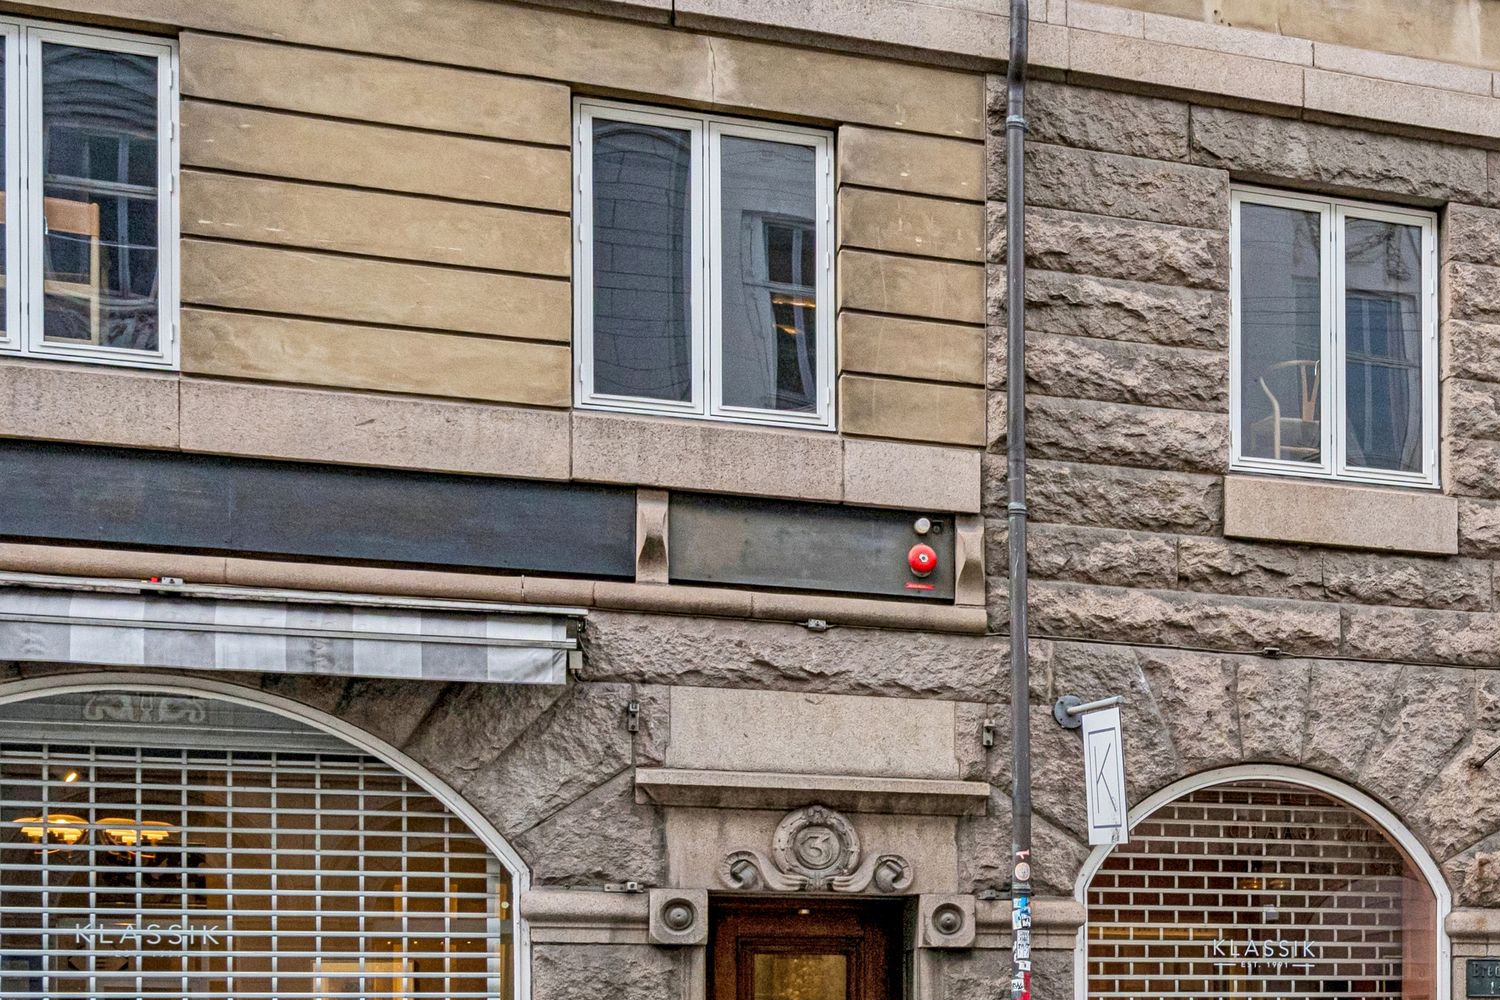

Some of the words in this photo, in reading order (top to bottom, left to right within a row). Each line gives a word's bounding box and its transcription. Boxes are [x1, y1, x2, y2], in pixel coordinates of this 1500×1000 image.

[1094, 743, 1117, 814] K
[75, 923, 220, 945] KLASSIK
[1213, 939, 1316, 957] KLASSIK
